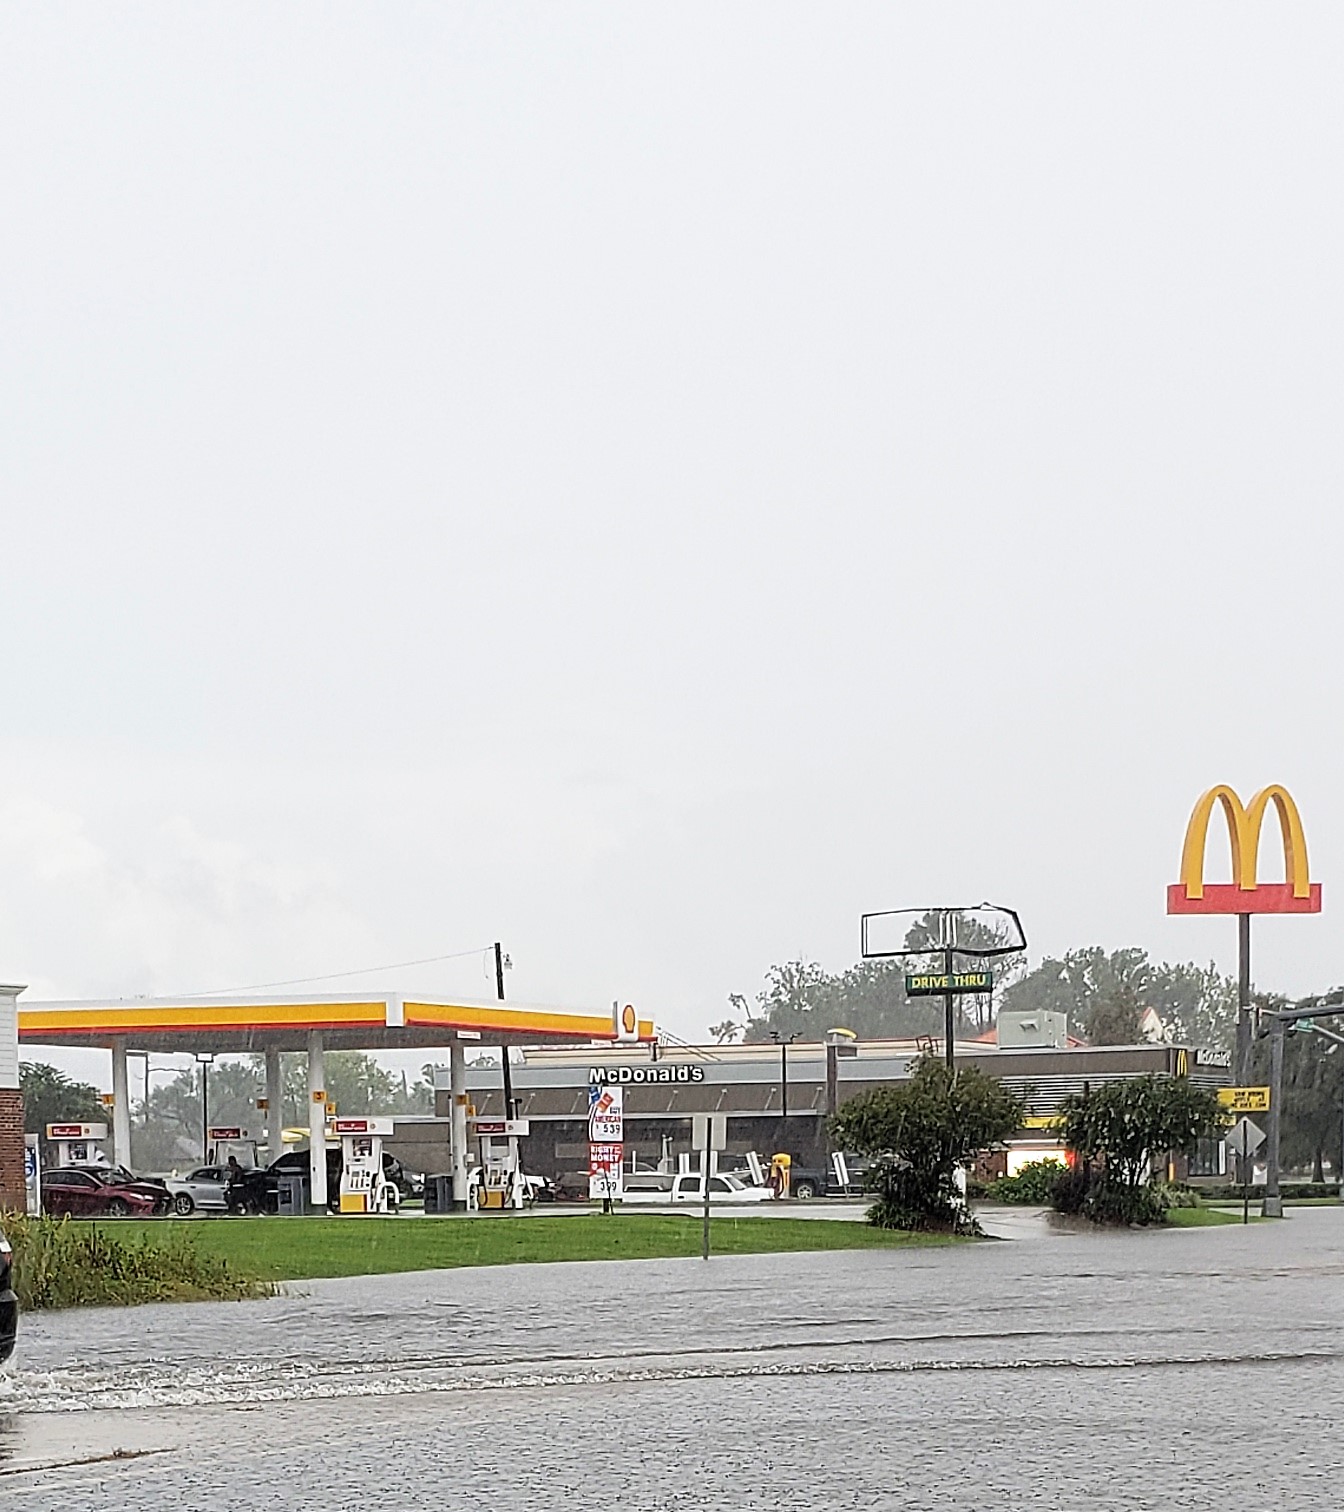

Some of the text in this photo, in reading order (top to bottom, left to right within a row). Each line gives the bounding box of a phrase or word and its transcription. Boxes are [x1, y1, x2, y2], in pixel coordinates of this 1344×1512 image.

[911, 974, 986, 989] DRIVE THRU
[588, 1065, 704, 1084] McDonald's
